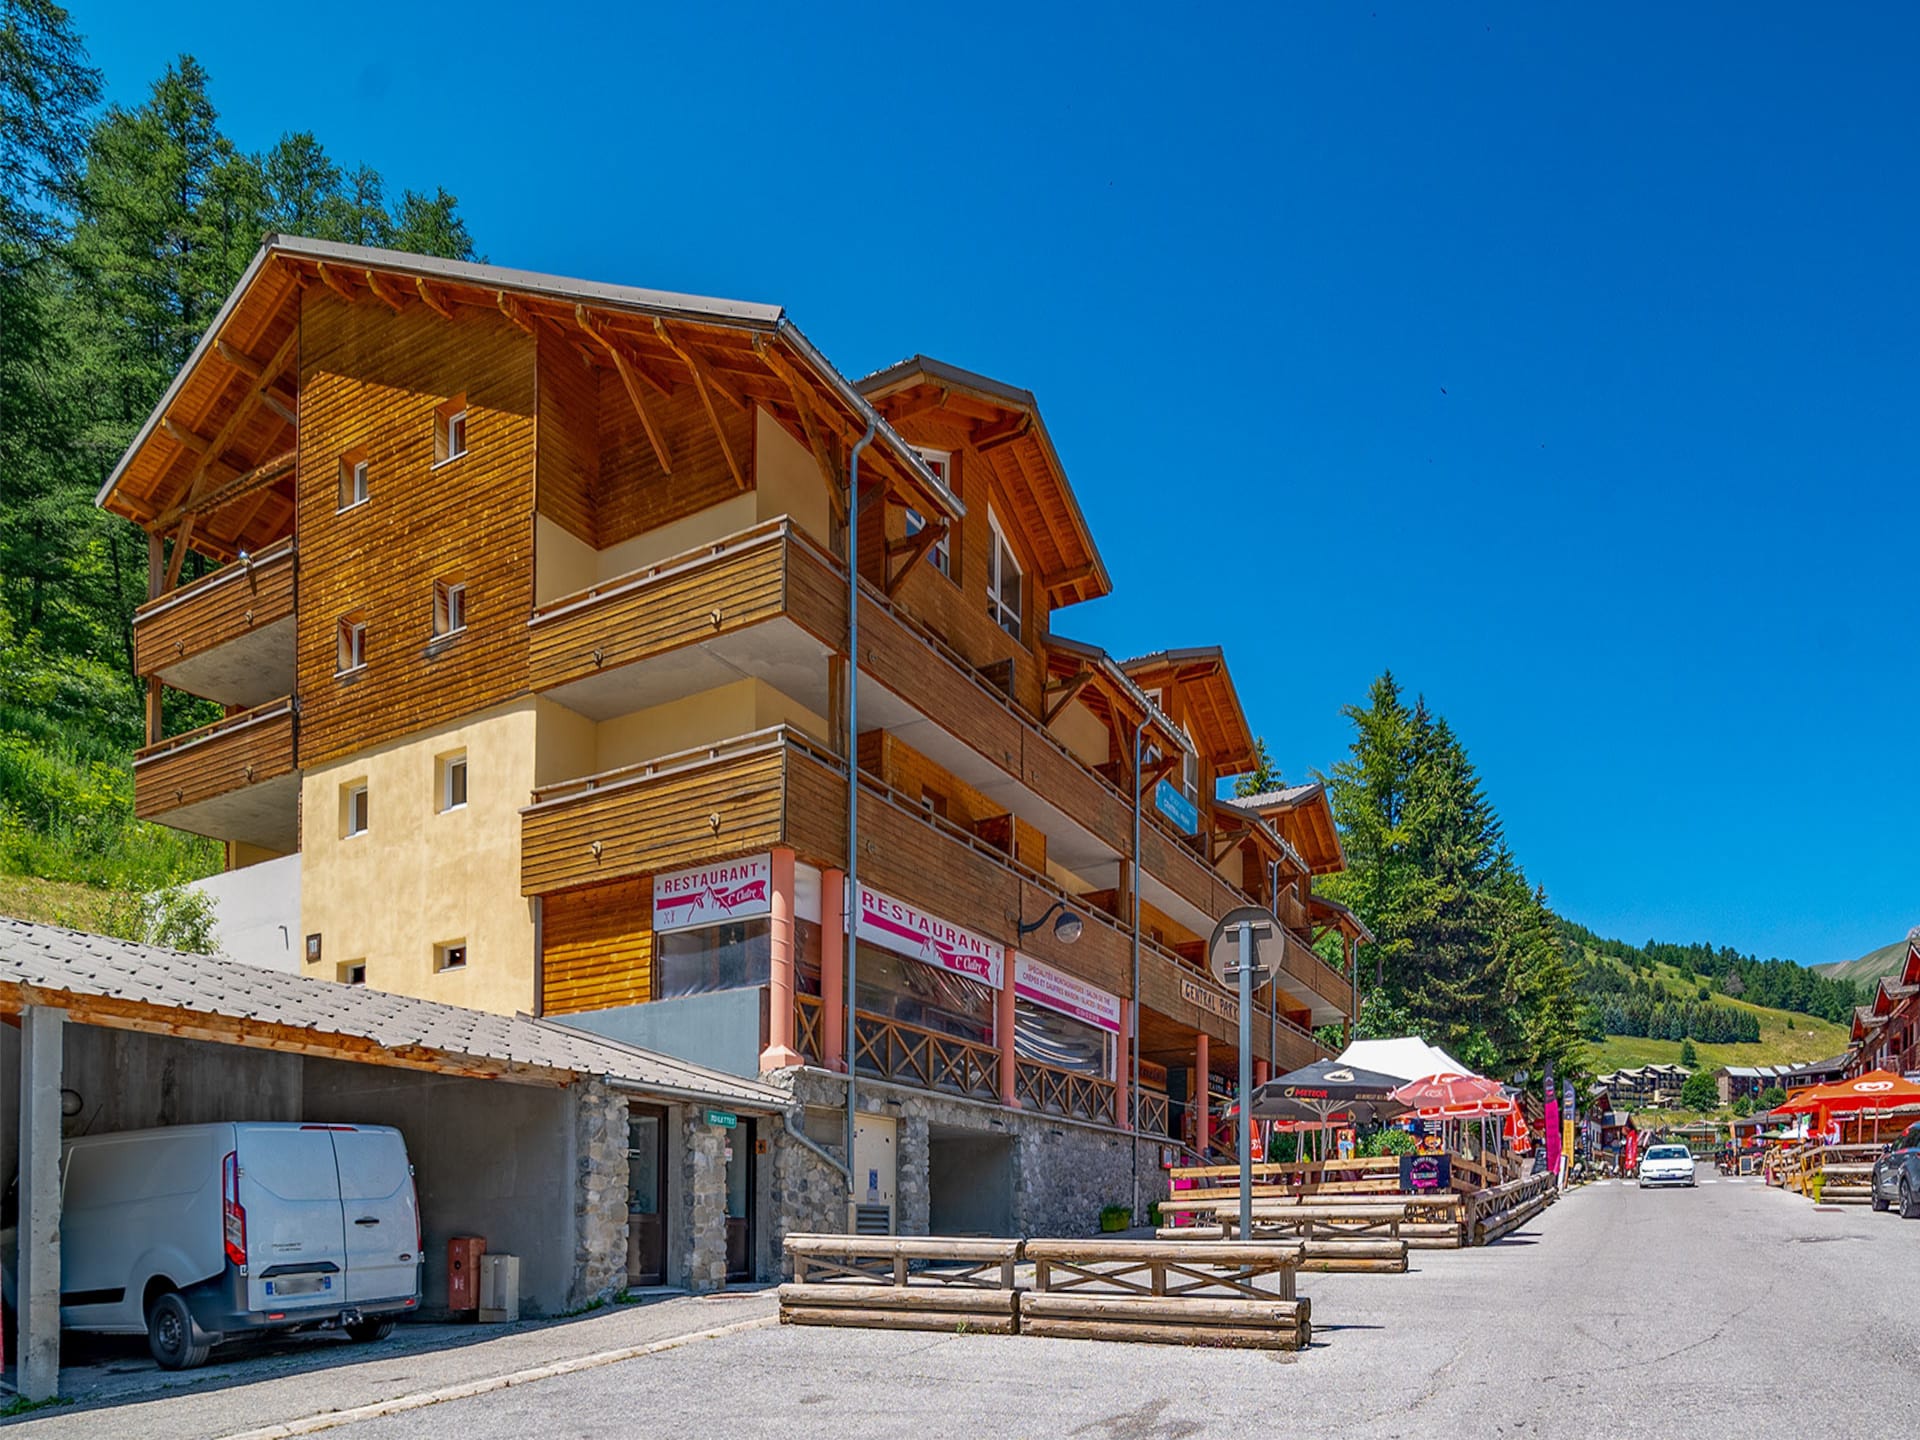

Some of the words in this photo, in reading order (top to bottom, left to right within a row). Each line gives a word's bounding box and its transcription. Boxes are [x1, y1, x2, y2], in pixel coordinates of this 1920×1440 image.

[664, 863, 758, 893] RESTAURANT
[862, 890, 992, 957] RESTAURANT
[1185, 983, 1216, 1011] CENTRAL
[1295, 1088, 1328, 1098] METEOR
[710, 1114, 735, 1125] TOILETTES
